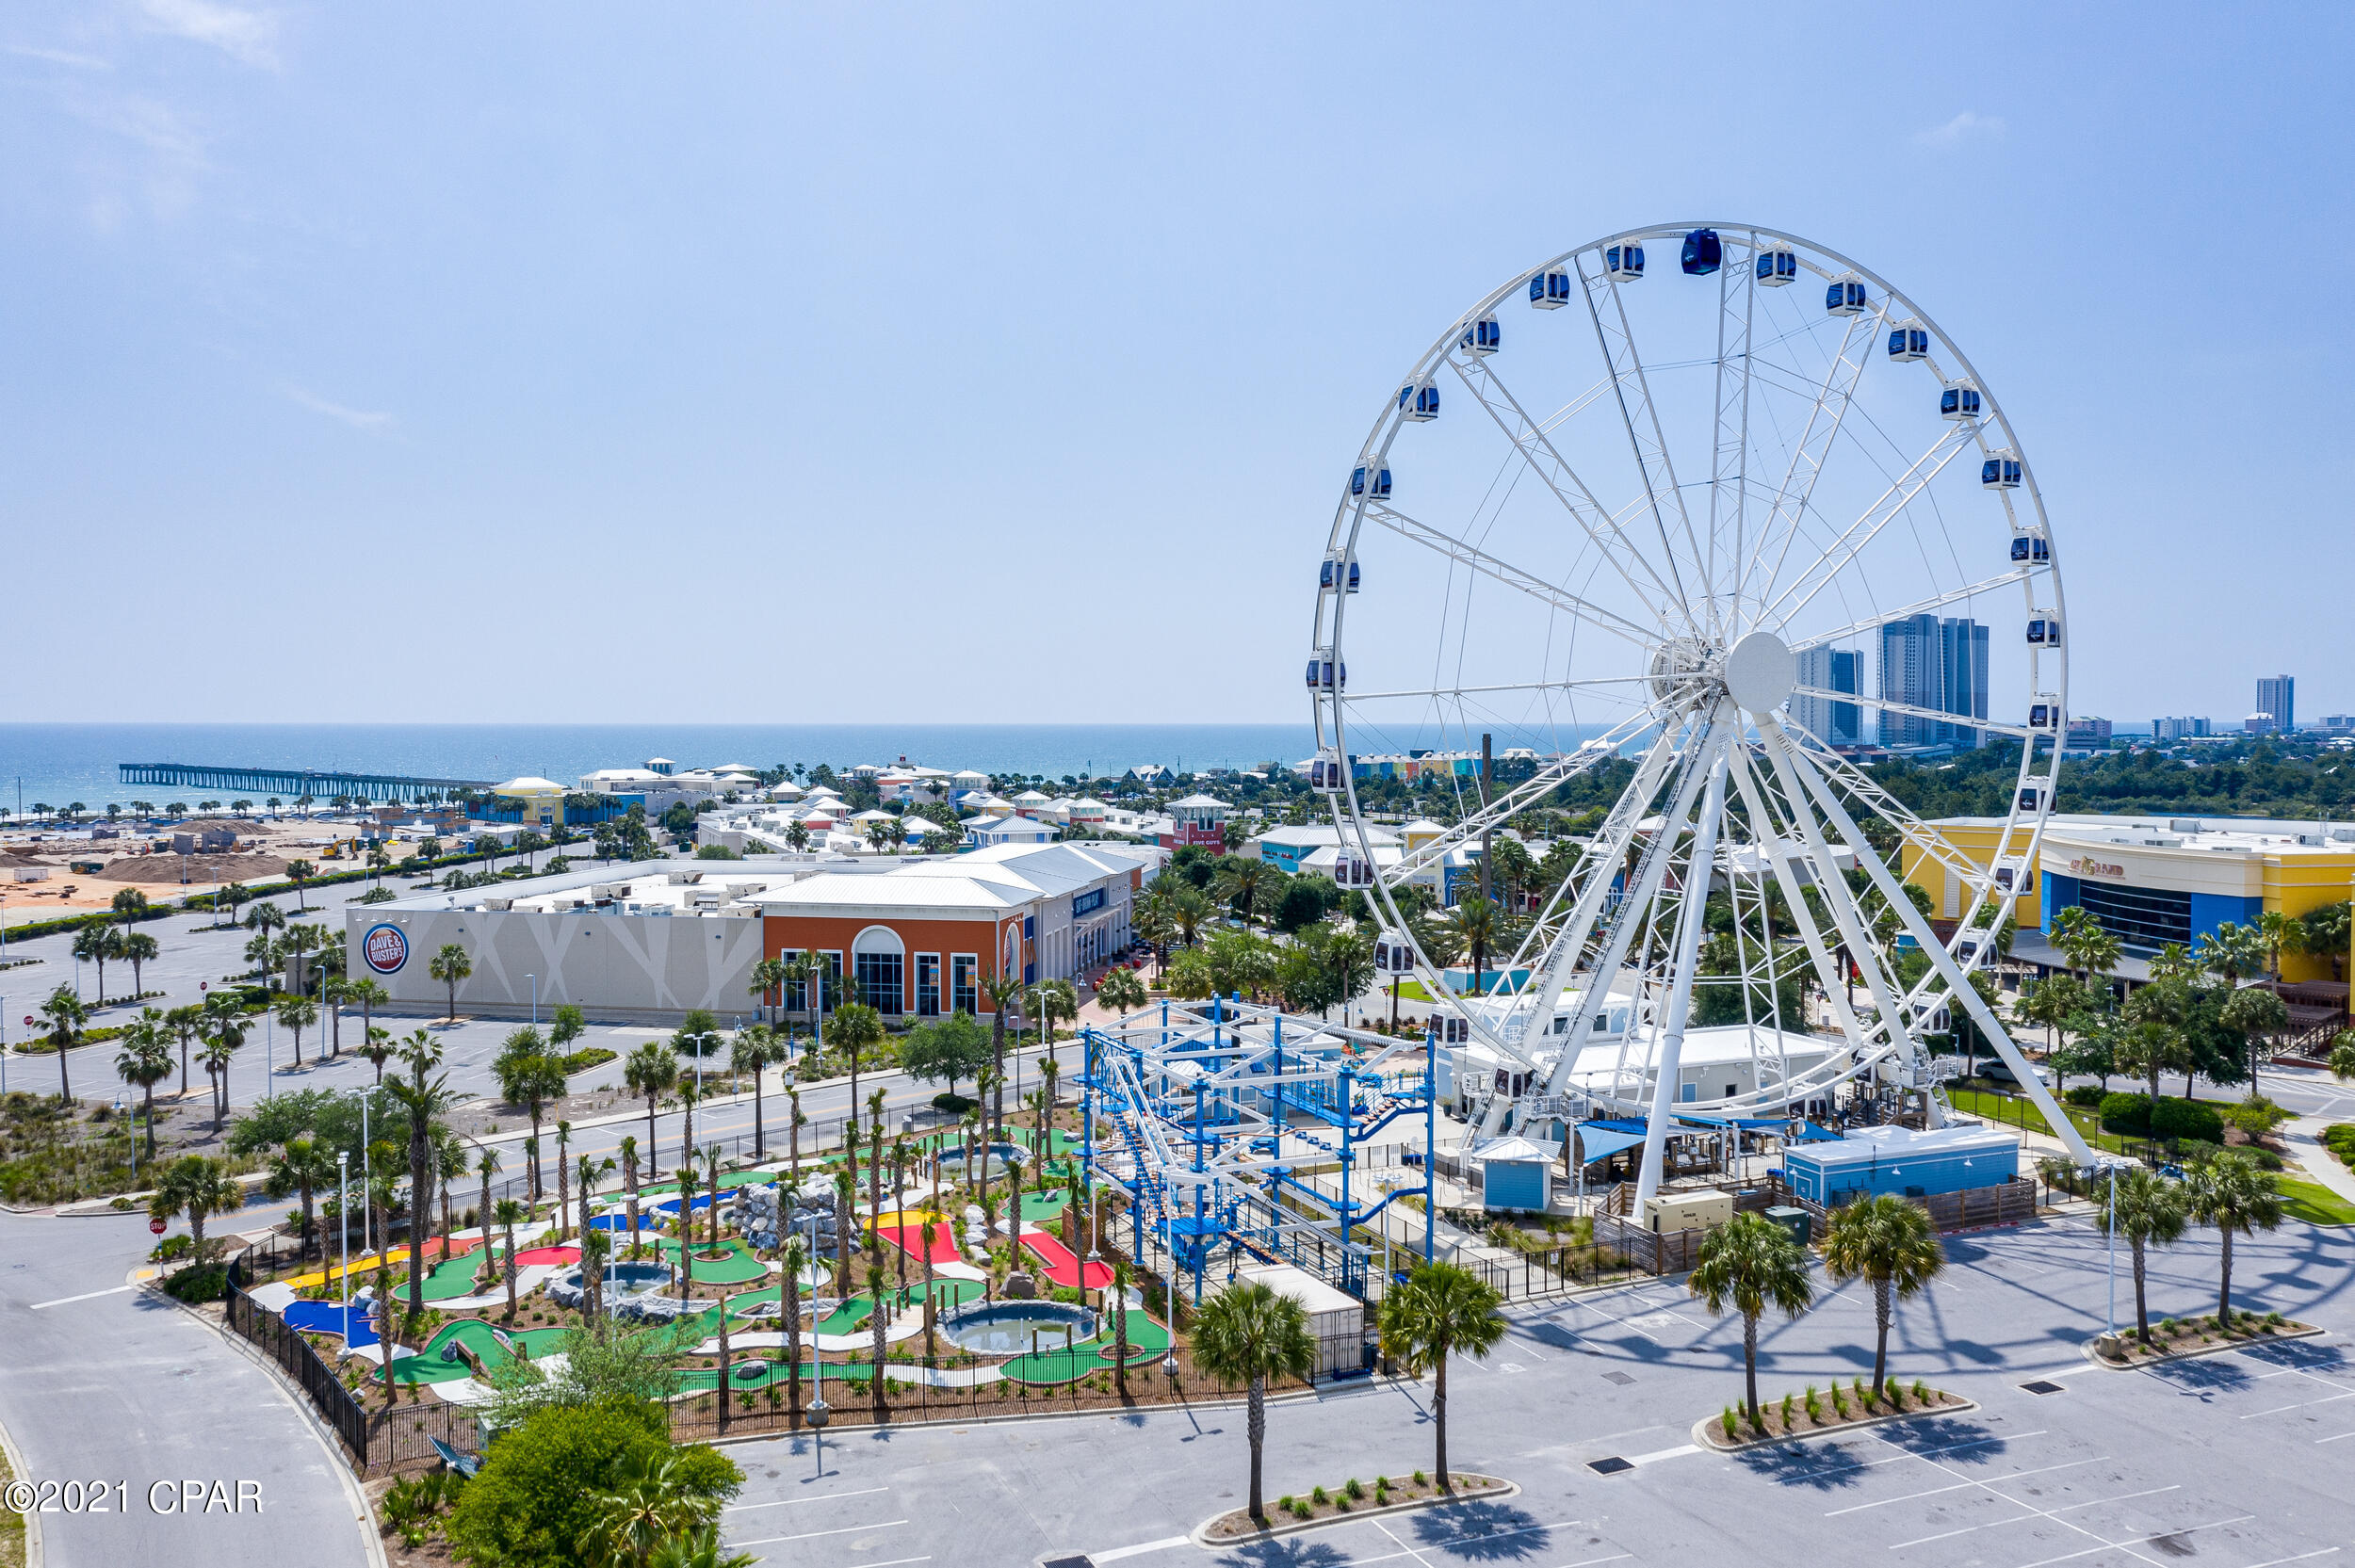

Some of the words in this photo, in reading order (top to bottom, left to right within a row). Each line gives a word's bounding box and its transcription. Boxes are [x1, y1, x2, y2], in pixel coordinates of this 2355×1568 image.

[370, 935, 394, 951] DAVE
[394, 935, 401, 946] &
[371, 946, 403, 962] BUSTER'S
